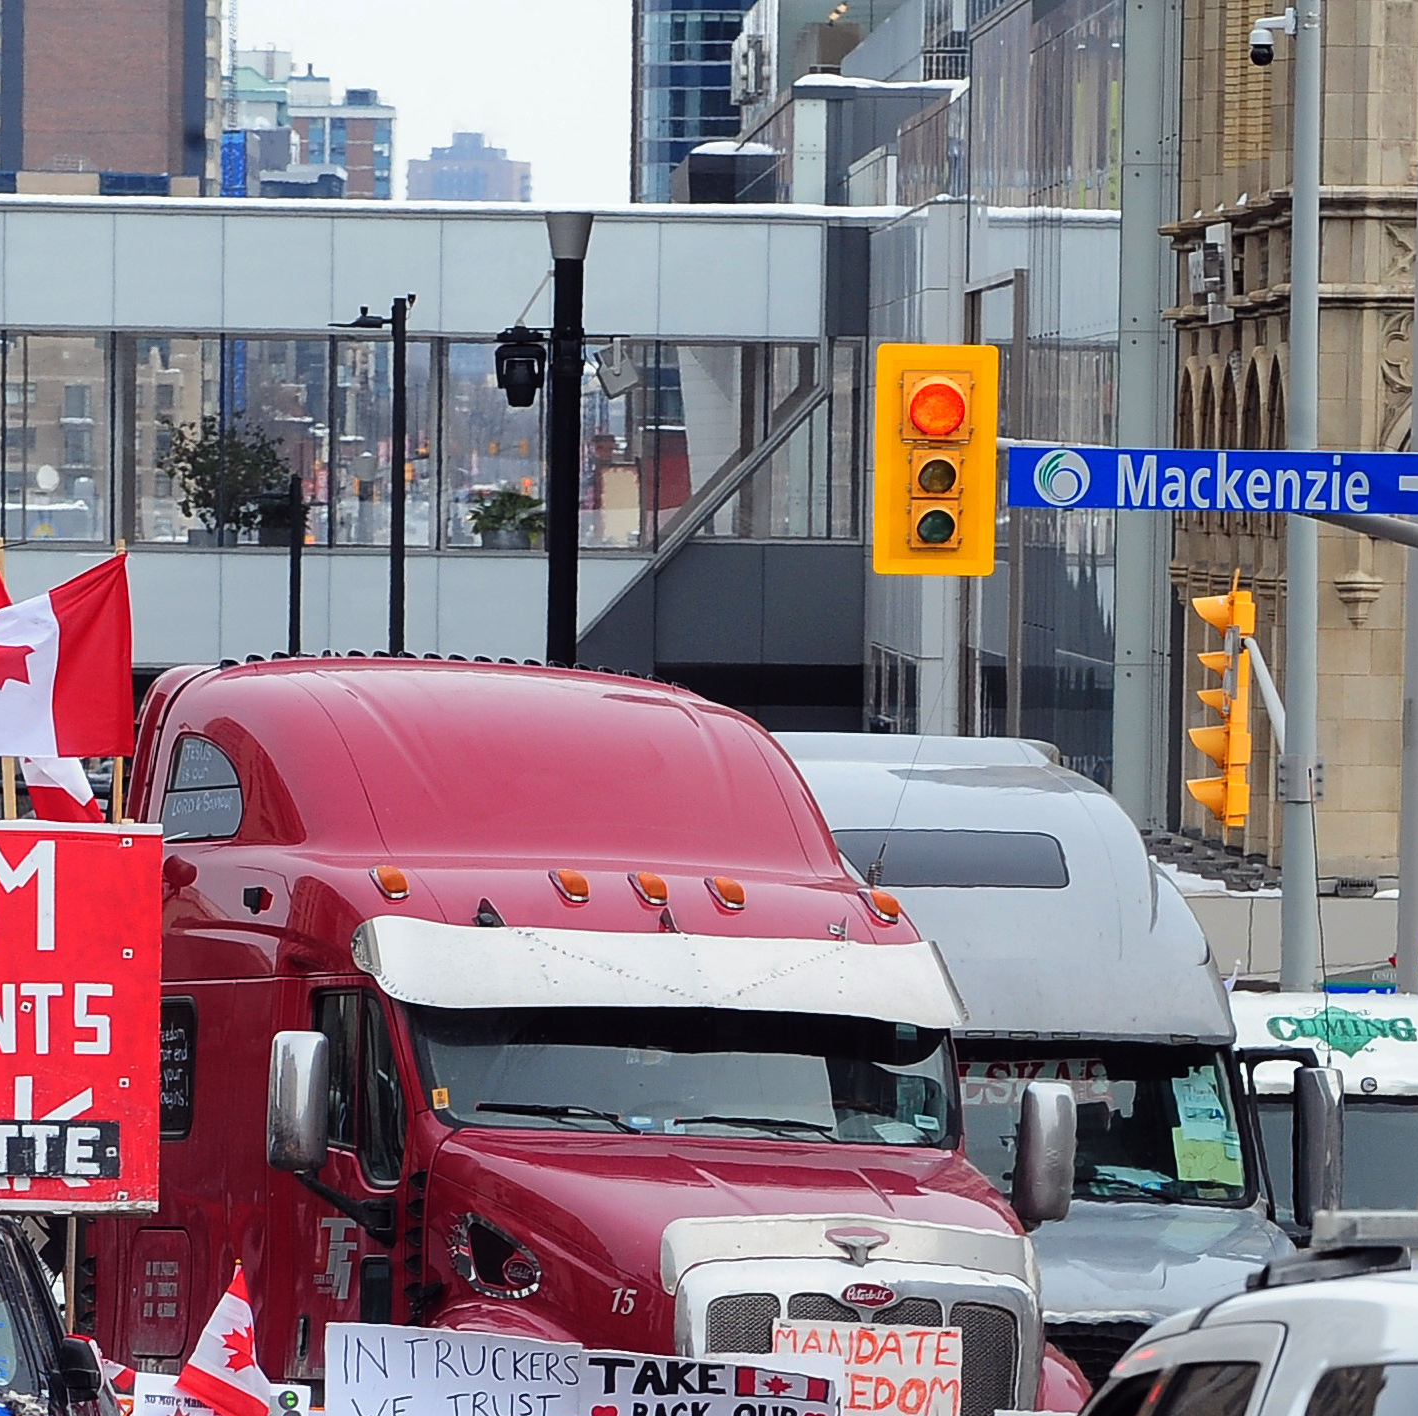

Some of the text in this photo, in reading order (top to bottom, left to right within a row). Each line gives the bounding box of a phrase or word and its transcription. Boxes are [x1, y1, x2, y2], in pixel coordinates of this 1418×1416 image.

[1116, 453, 1370, 513] Mackenzie
[611, 1287, 638, 1315] 15
[845, 1285, 891, 1302] Peterbilt
[344, 1334, 580, 1386] IN TRUCKERS
[773, 1328, 959, 1367] MANDATE
[588, 1357, 726, 1396] TAKE
